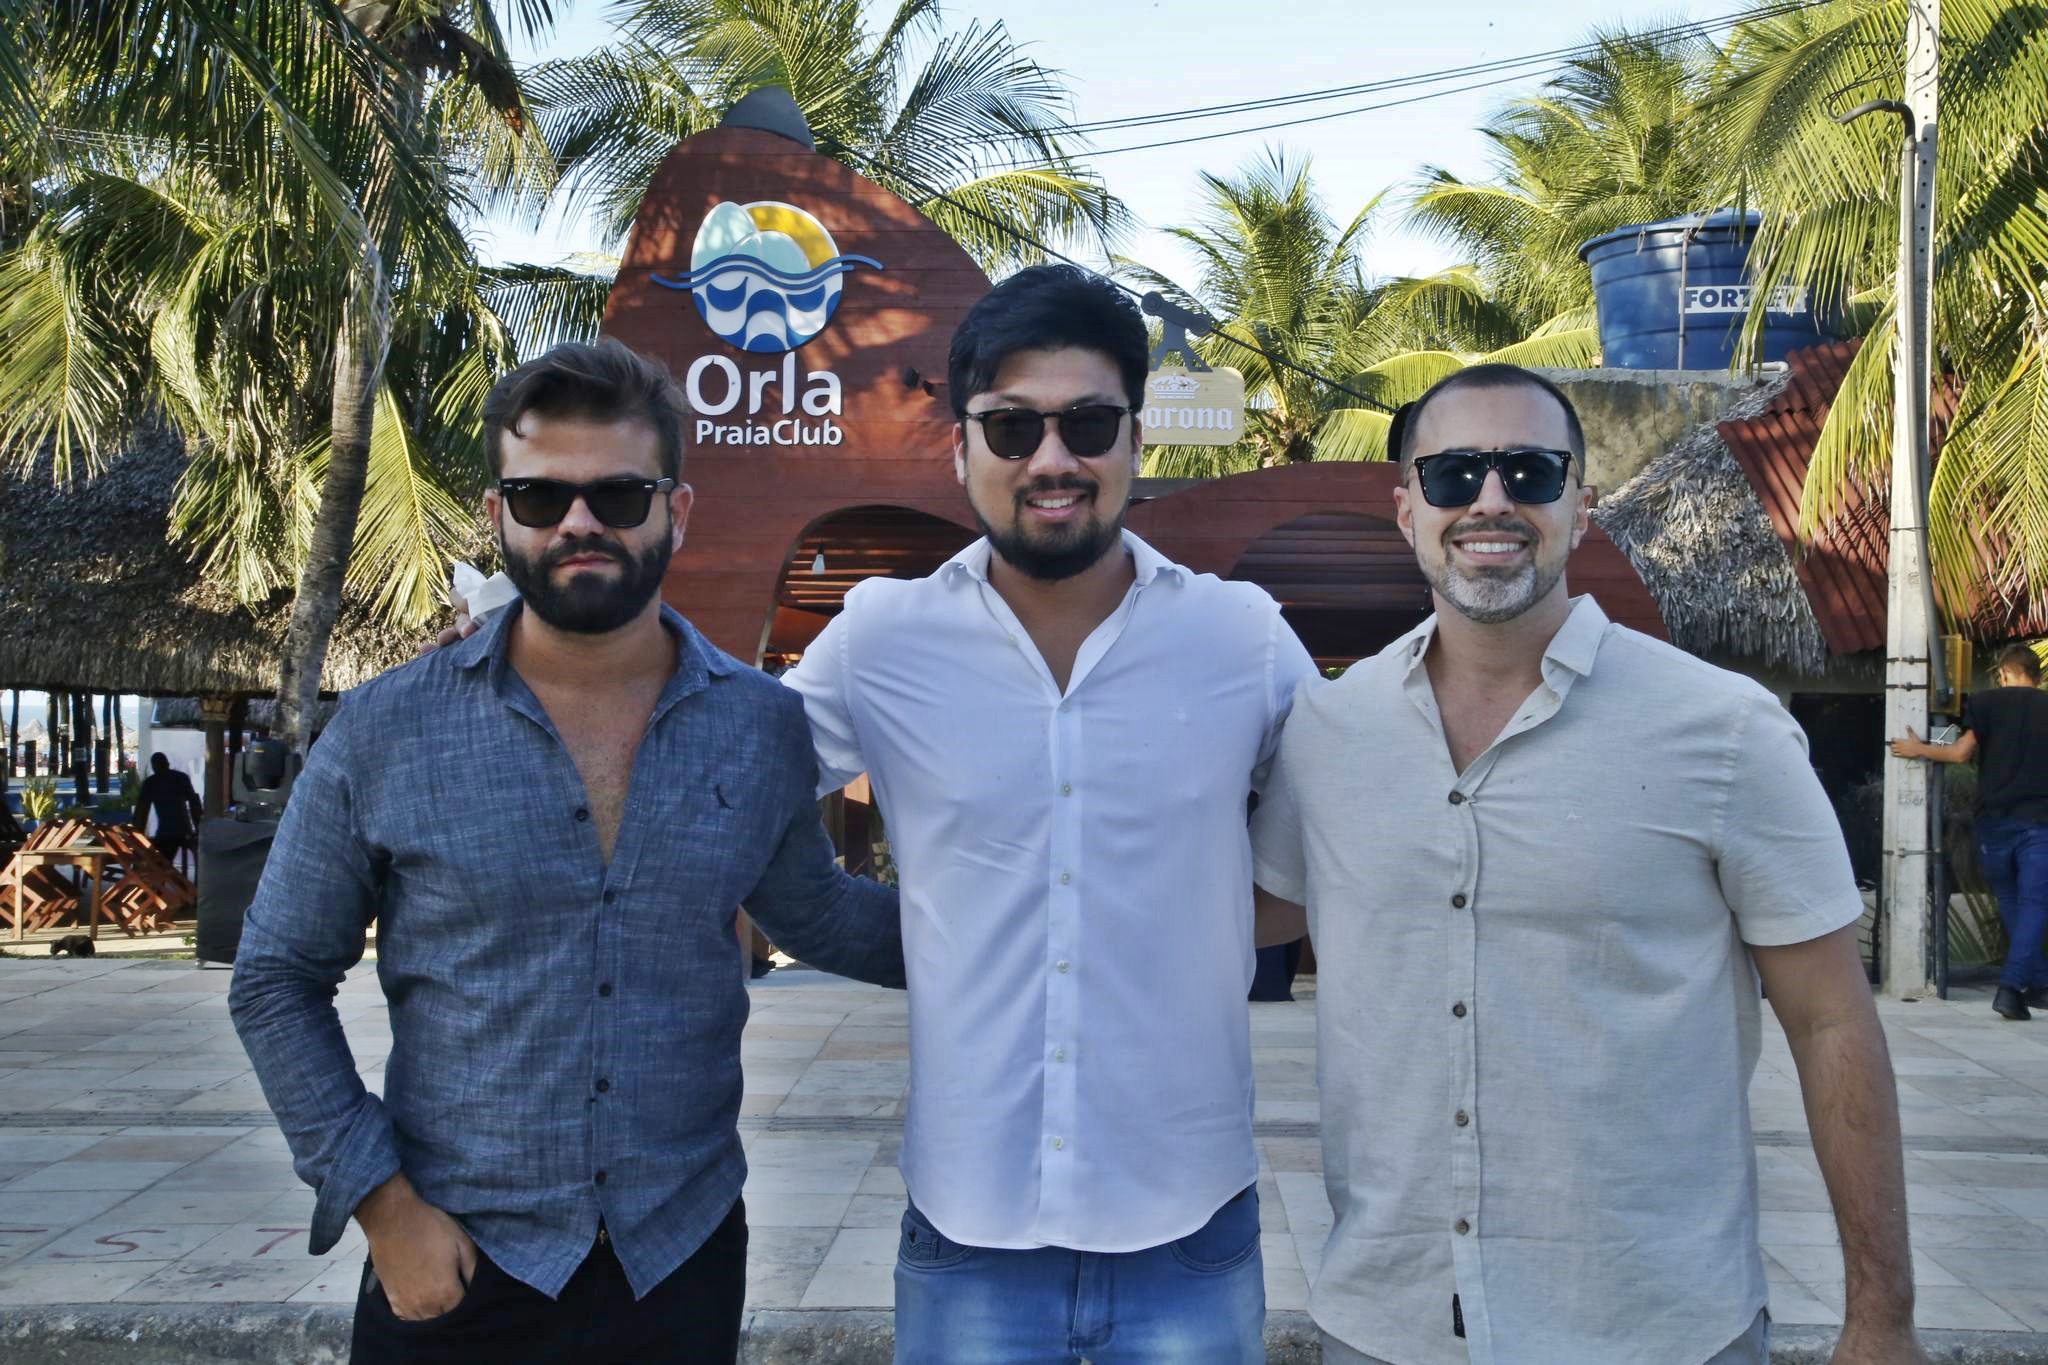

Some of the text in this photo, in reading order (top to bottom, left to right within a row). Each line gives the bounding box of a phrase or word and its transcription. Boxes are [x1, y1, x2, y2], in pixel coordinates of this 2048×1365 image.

[1684, 288, 1802, 309] FORT
[686, 352, 842, 416] Orla
[1143, 403, 1234, 431] orona
